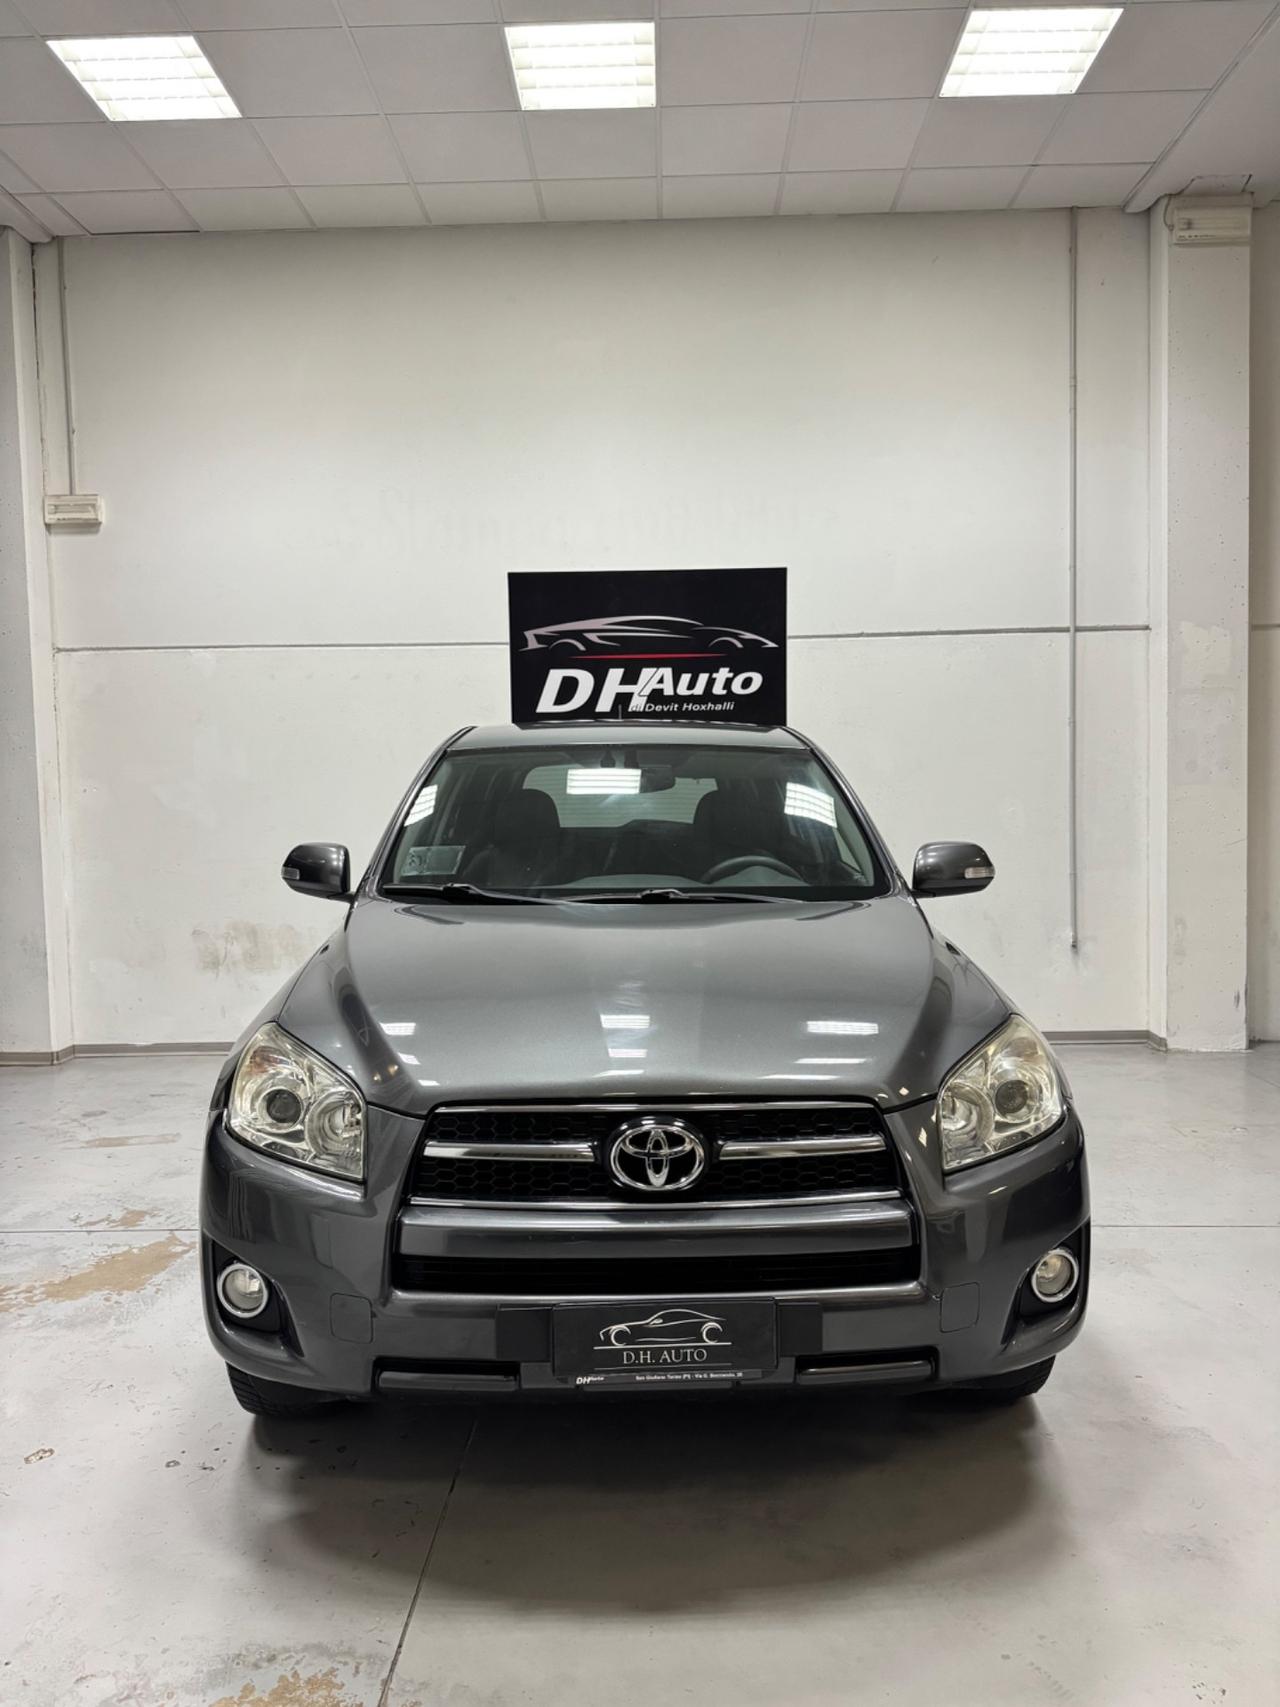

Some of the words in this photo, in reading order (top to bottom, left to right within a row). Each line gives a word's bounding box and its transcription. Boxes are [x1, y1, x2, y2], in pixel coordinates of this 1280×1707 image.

[645, 702, 679, 712] Devit
[682, 701, 735, 711] Hoxhalli
[623, 1350, 655, 1364] D.H.
[660, 1348, 707, 1363] AUTO
